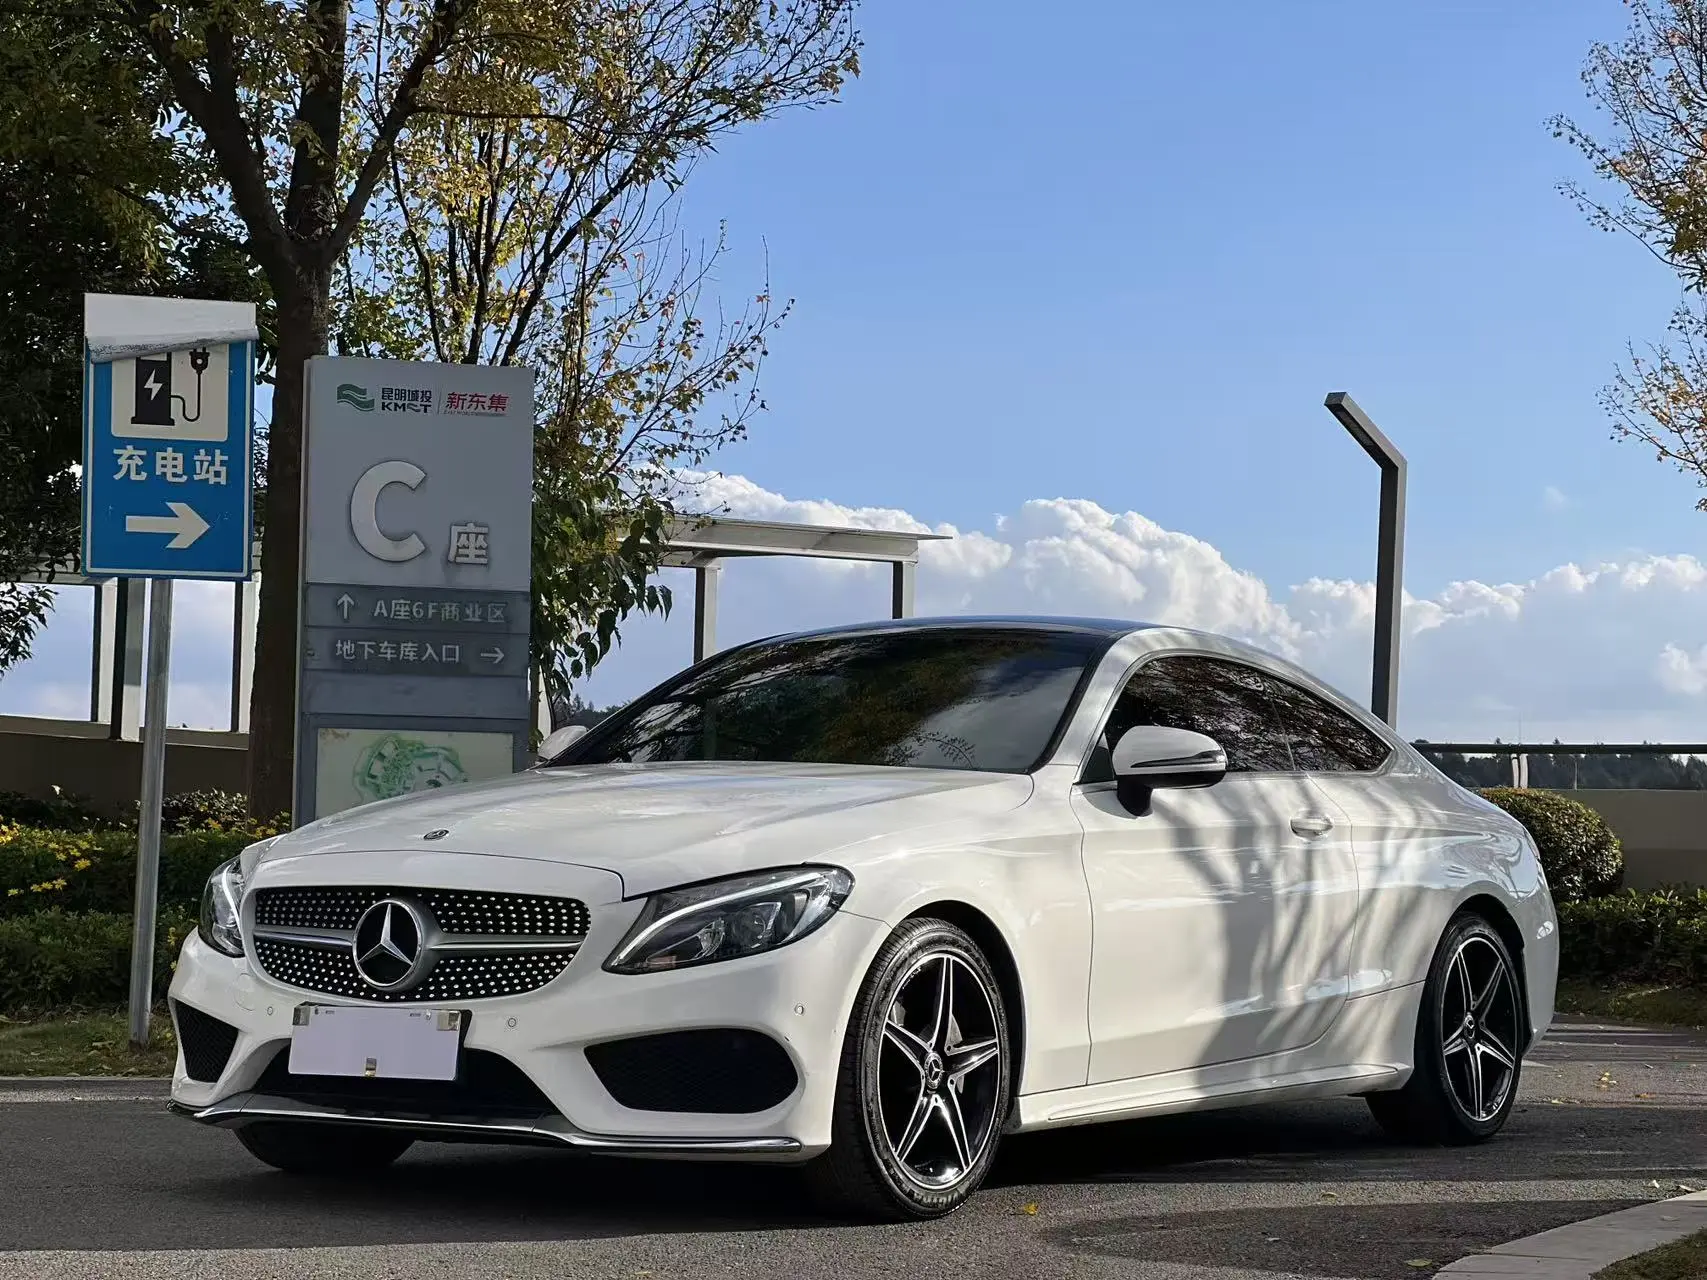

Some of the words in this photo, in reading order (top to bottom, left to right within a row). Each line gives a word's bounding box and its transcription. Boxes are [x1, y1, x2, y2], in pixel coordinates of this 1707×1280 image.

[381, 387, 433, 403] 昆明城投
[445, 391, 509, 412] 新东集
[113, 445, 229, 485] 充电站
[373, 598, 507, 623] A座6F商业区
[335, 639, 460, 663] 地下车库入口
